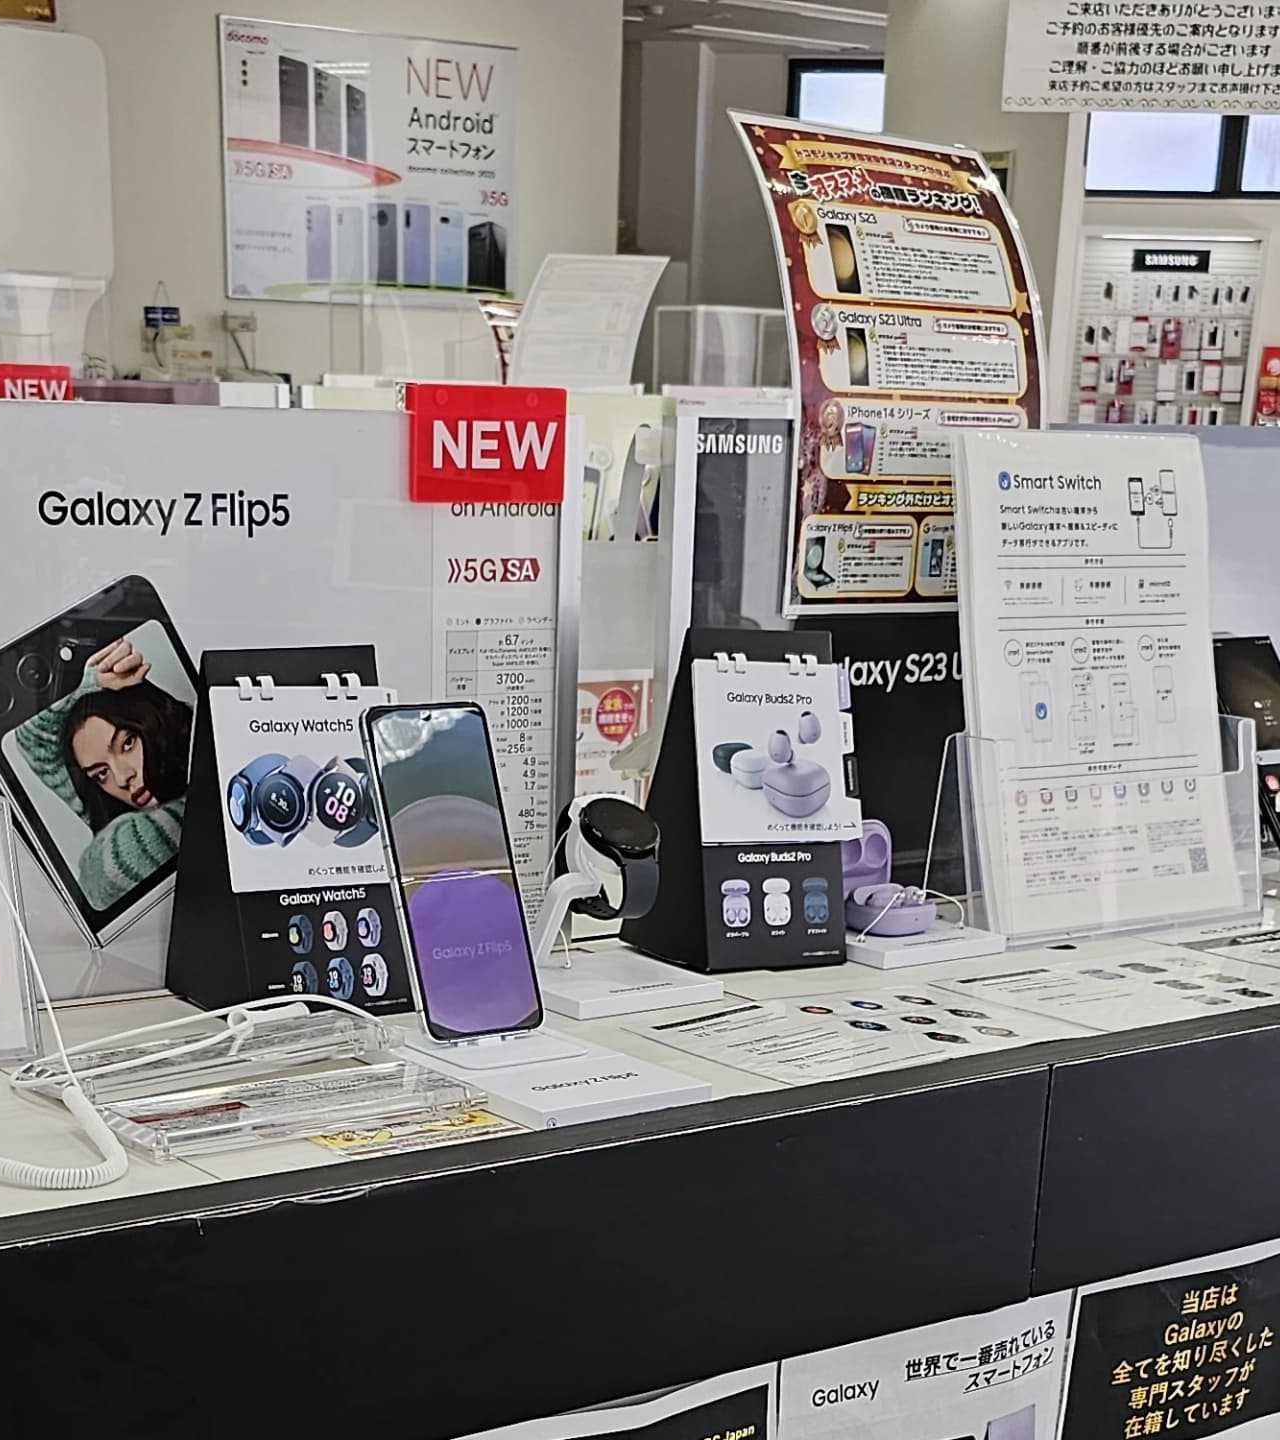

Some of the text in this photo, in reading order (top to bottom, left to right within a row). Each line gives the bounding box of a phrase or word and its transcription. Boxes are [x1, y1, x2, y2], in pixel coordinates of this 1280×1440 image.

[406, 56, 494, 102] NEW
[408, 107, 494, 134] Android
[408, 138, 495, 160] スマートフォン
[817, 208, 877, 224] Galaxy S23
[1145, 255, 1199, 266] SAMSUNG
[839, 311, 922, 328] Galaxy S23 Ultra
[3, 379, 68, 401] NEW
[898, 409, 930, 420] シリーズ
[432, 420, 558, 471] NEW
[696, 432, 782, 455] SAMSUNG
[1013, 474, 1101, 490] Smart Switch
[37, 491, 291, 537] Galaxy Z Flip5
[1000, 505, 1025, 514] Smart
[463, 558, 497, 583] 5G
[505, 634, 519, 646] 6.7
[904, 652, 947, 683] S23
[496, 673, 524, 685] 3700
[506, 695, 529, 706] 1200
[727, 692, 812, 706] Galaxy Buds2 Pro
[506, 707, 529, 716] 1200
[249, 719, 354, 736] Galaxy Watch5
[506, 719, 529, 729] 1000
[507, 744, 526, 754] 256
[523, 757, 536, 766] 4.9
[518, 809, 535, 818] 480
[524, 821, 535, 830] 75
[738, 852, 811, 865] Galaxy Buds2 Pro
[280, 888, 366, 905] Galaxy Watch5
[433, 942, 512, 961] Galaxy Z Flip5
[531, 1078, 590, 1092] Galaxy
[1181, 1283, 1239, 1315] 当店は
[1165, 1311, 1243, 1345] Galaxyの
[904, 1319, 1055, 1381] 世界で一番売れている
[1112, 1326, 1274, 1385] 全てを知り尽くした
[963, 1346, 1054, 1393] スマートフォン
[1128, 1358, 1256, 1409] 専門スタッフが
[812, 1379, 880, 1408] Galaxy
[1124, 1388, 1250, 1439] 在籍しています
